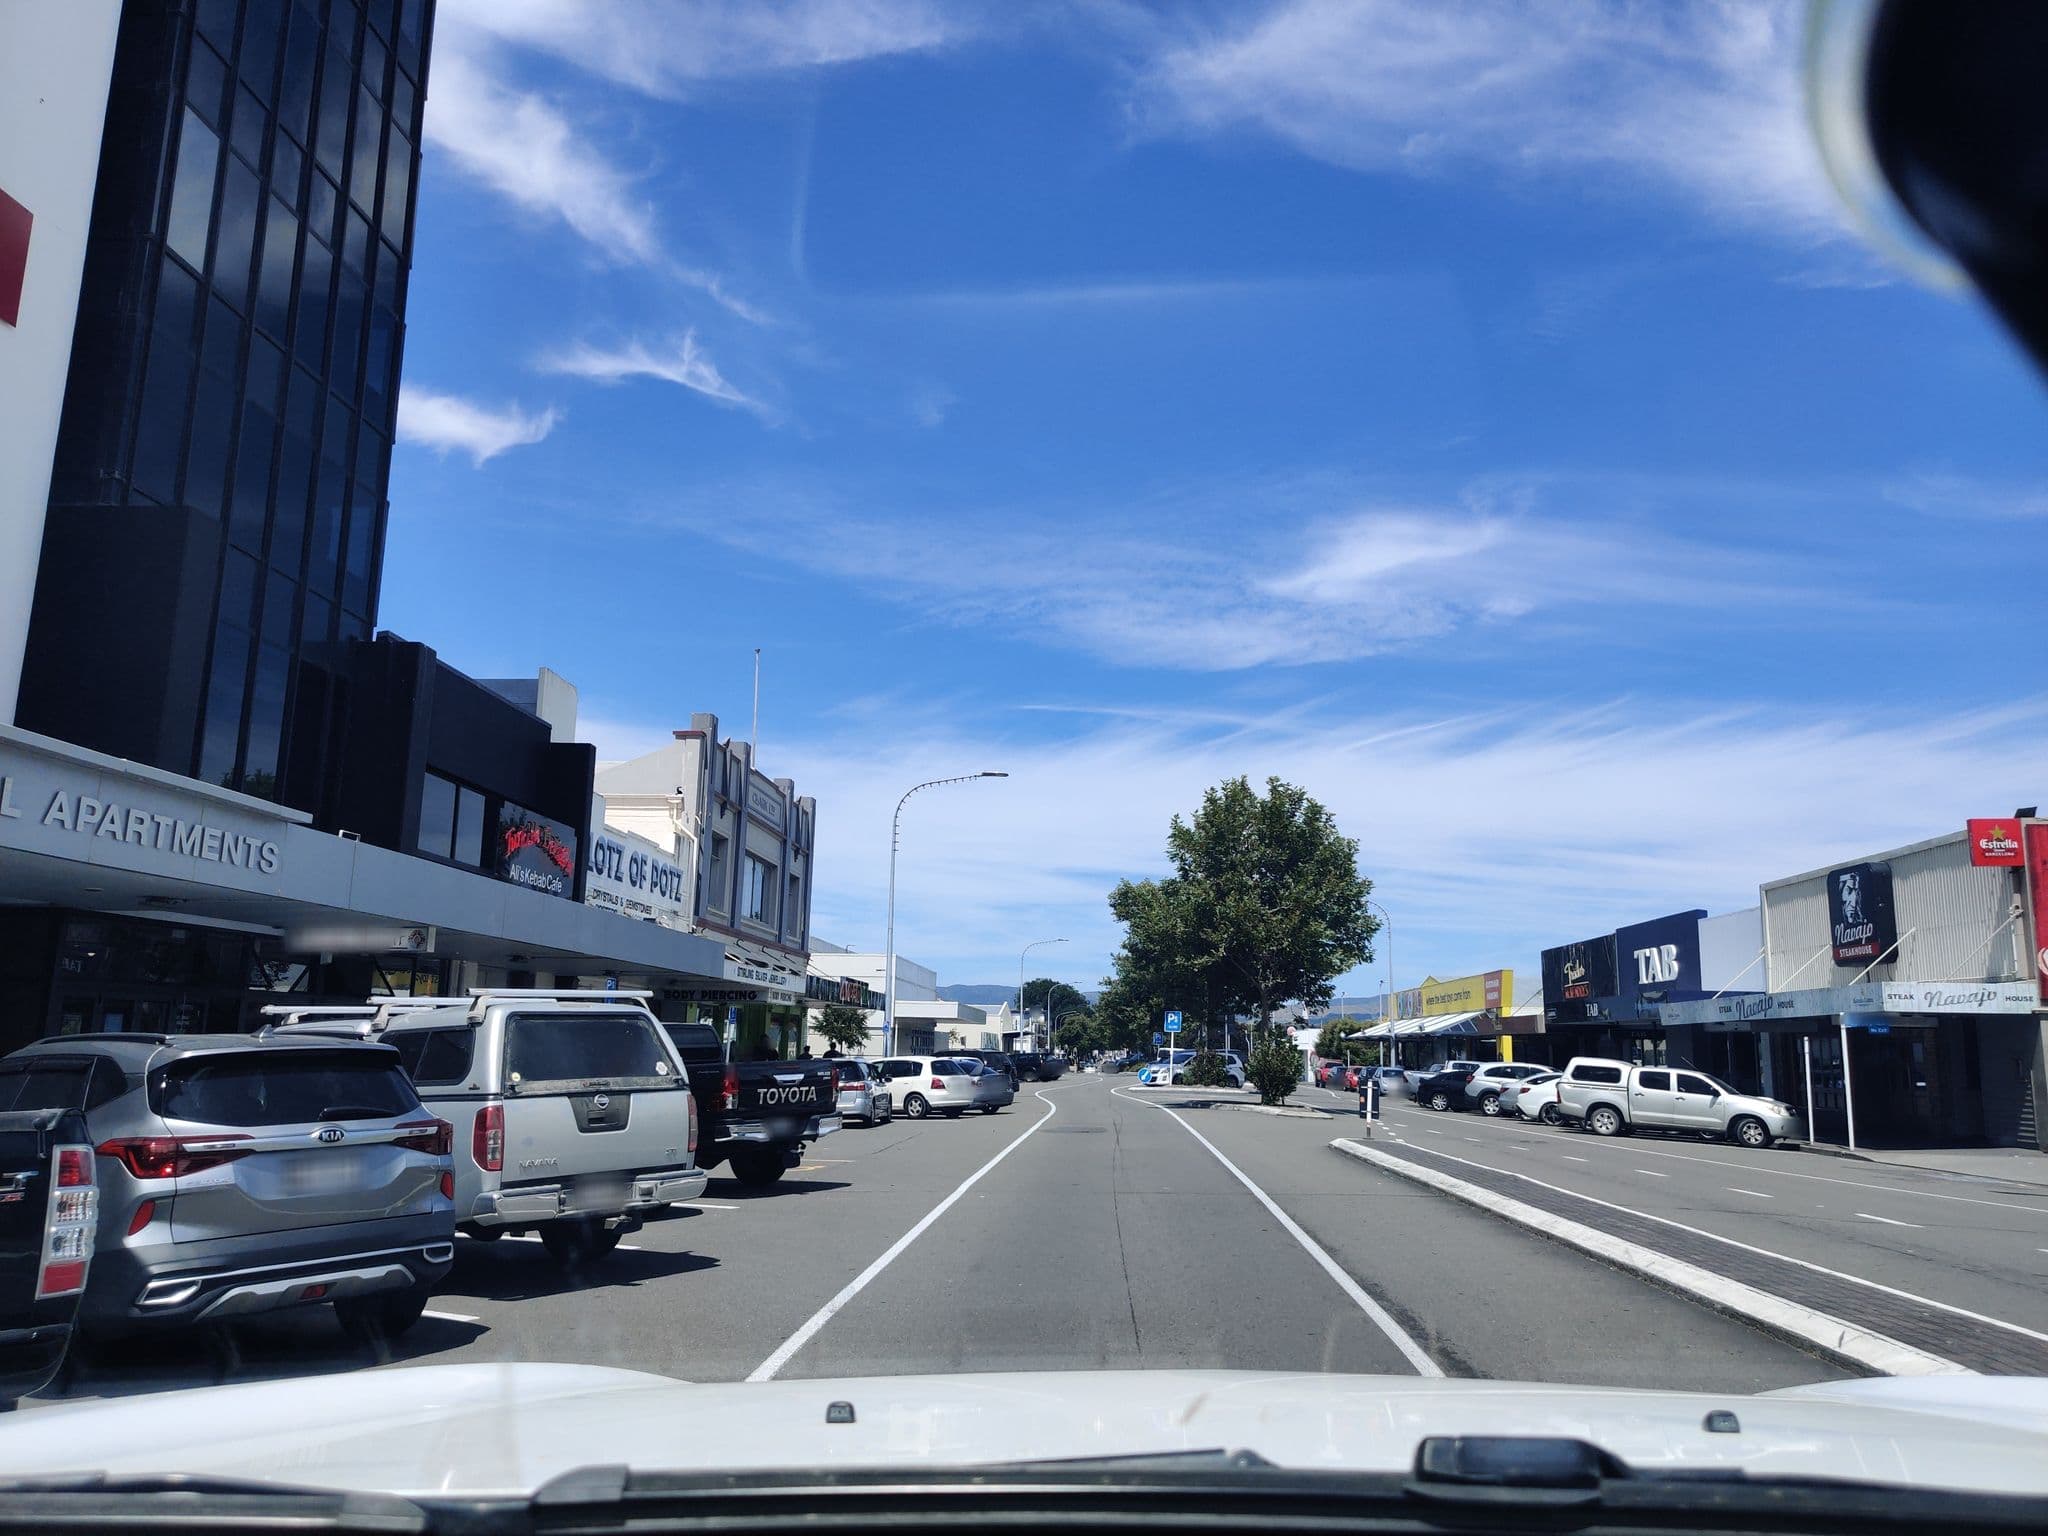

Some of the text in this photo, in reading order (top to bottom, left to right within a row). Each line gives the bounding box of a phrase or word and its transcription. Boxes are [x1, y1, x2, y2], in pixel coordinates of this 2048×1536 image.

[0, 776, 21, 818] L
[41, 791, 280, 875] APARTMENTS
[1979, 839, 2018, 849] Estrella
[524, 868, 546, 889] Kebab
[546, 874, 562, 892] Cafe
[629, 850, 648, 890] OF
[650, 856, 683, 903] POTZ
[1834, 918, 1873, 946] Navajo
[1839, 944, 1873, 958] STEAKHOUSE
[1633, 944, 1679, 984] TAB
[664, 990, 758, 1001] BODY PIERCING
[1887, 993, 1915, 1001] STEAK
[1924, 987, 1997, 1008] Navajo
[1586, 1003, 1599, 1017] TAB
[1719, 996, 1794, 1020] STEAK Navajo HOUSE
[757, 1086, 817, 1105] TOYOTA
[322, 1131, 342, 1141] KIA
